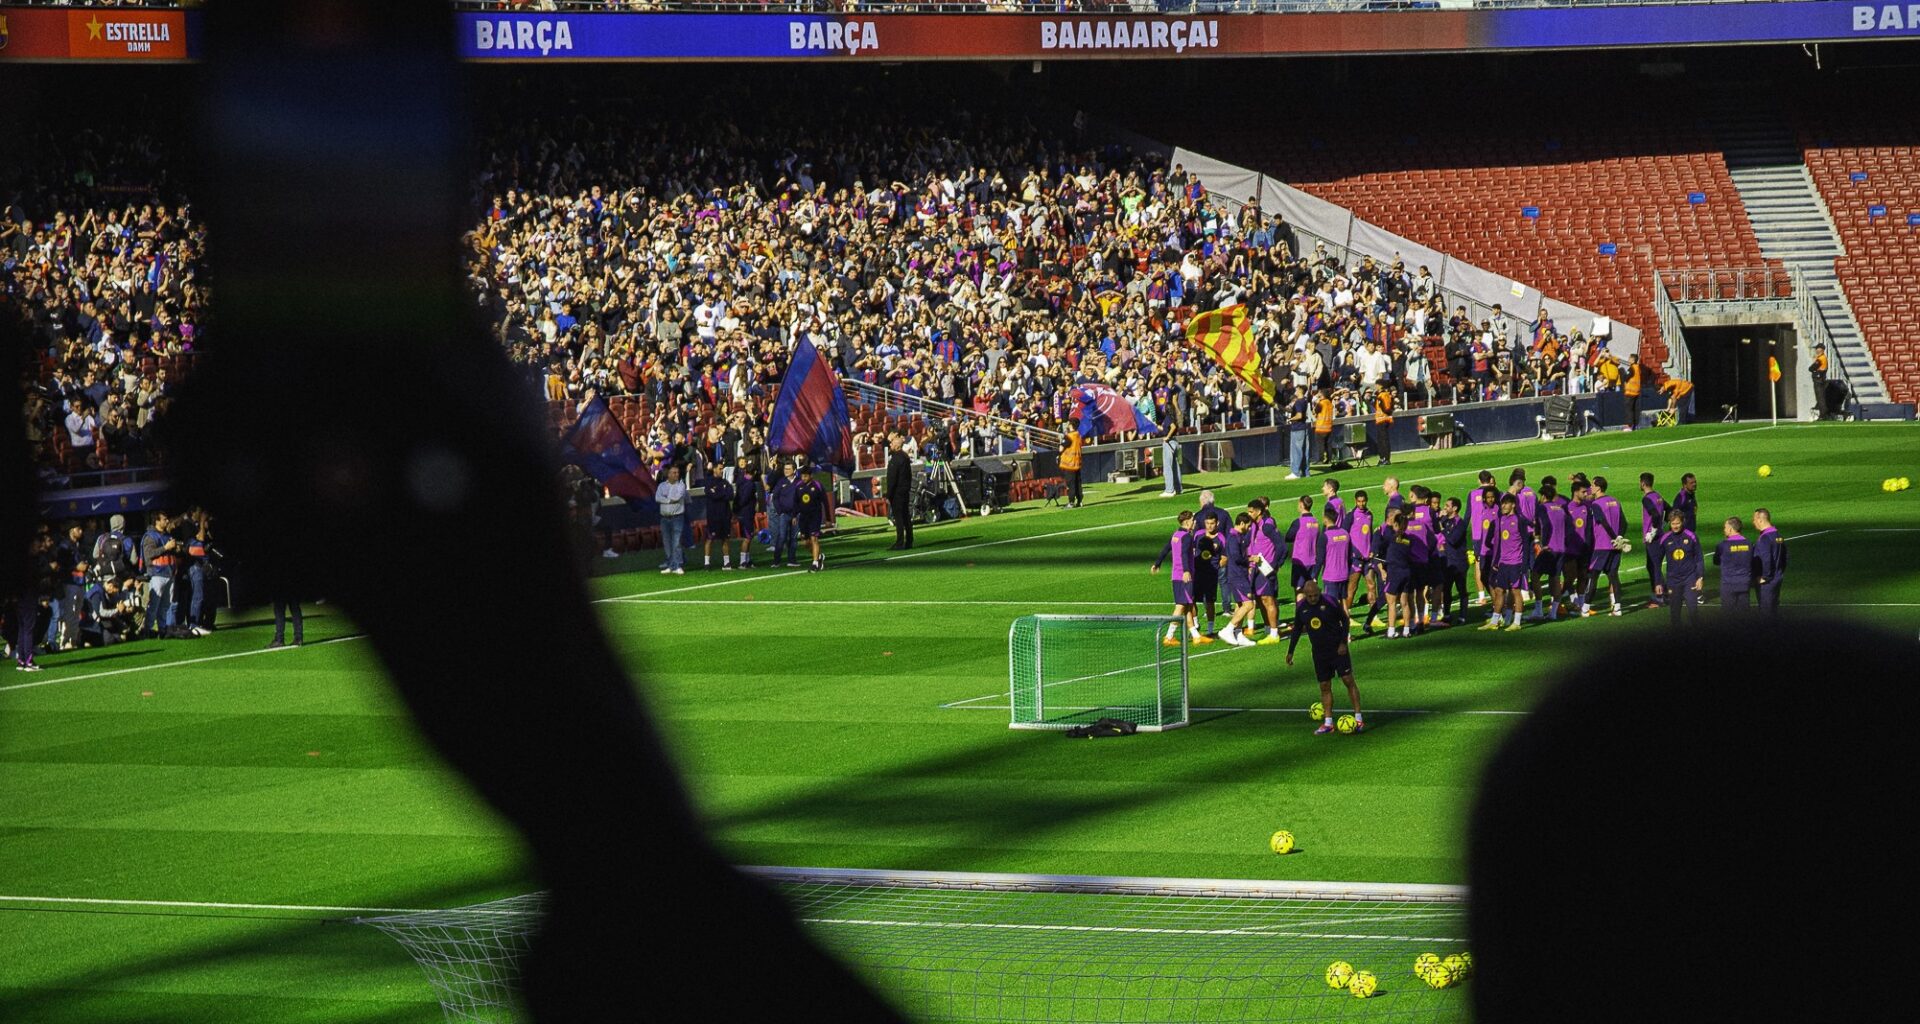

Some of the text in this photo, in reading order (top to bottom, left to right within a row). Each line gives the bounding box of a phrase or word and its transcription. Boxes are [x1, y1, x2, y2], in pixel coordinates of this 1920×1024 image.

[106, 23, 170, 41] ESTRELLA
[127, 42, 151, 52] DAMM
[476, 20, 573, 56] BARÇA
[789, 21, 879, 56] BARÇA
[1040, 20, 1219, 53] BAAAAARÇA!
